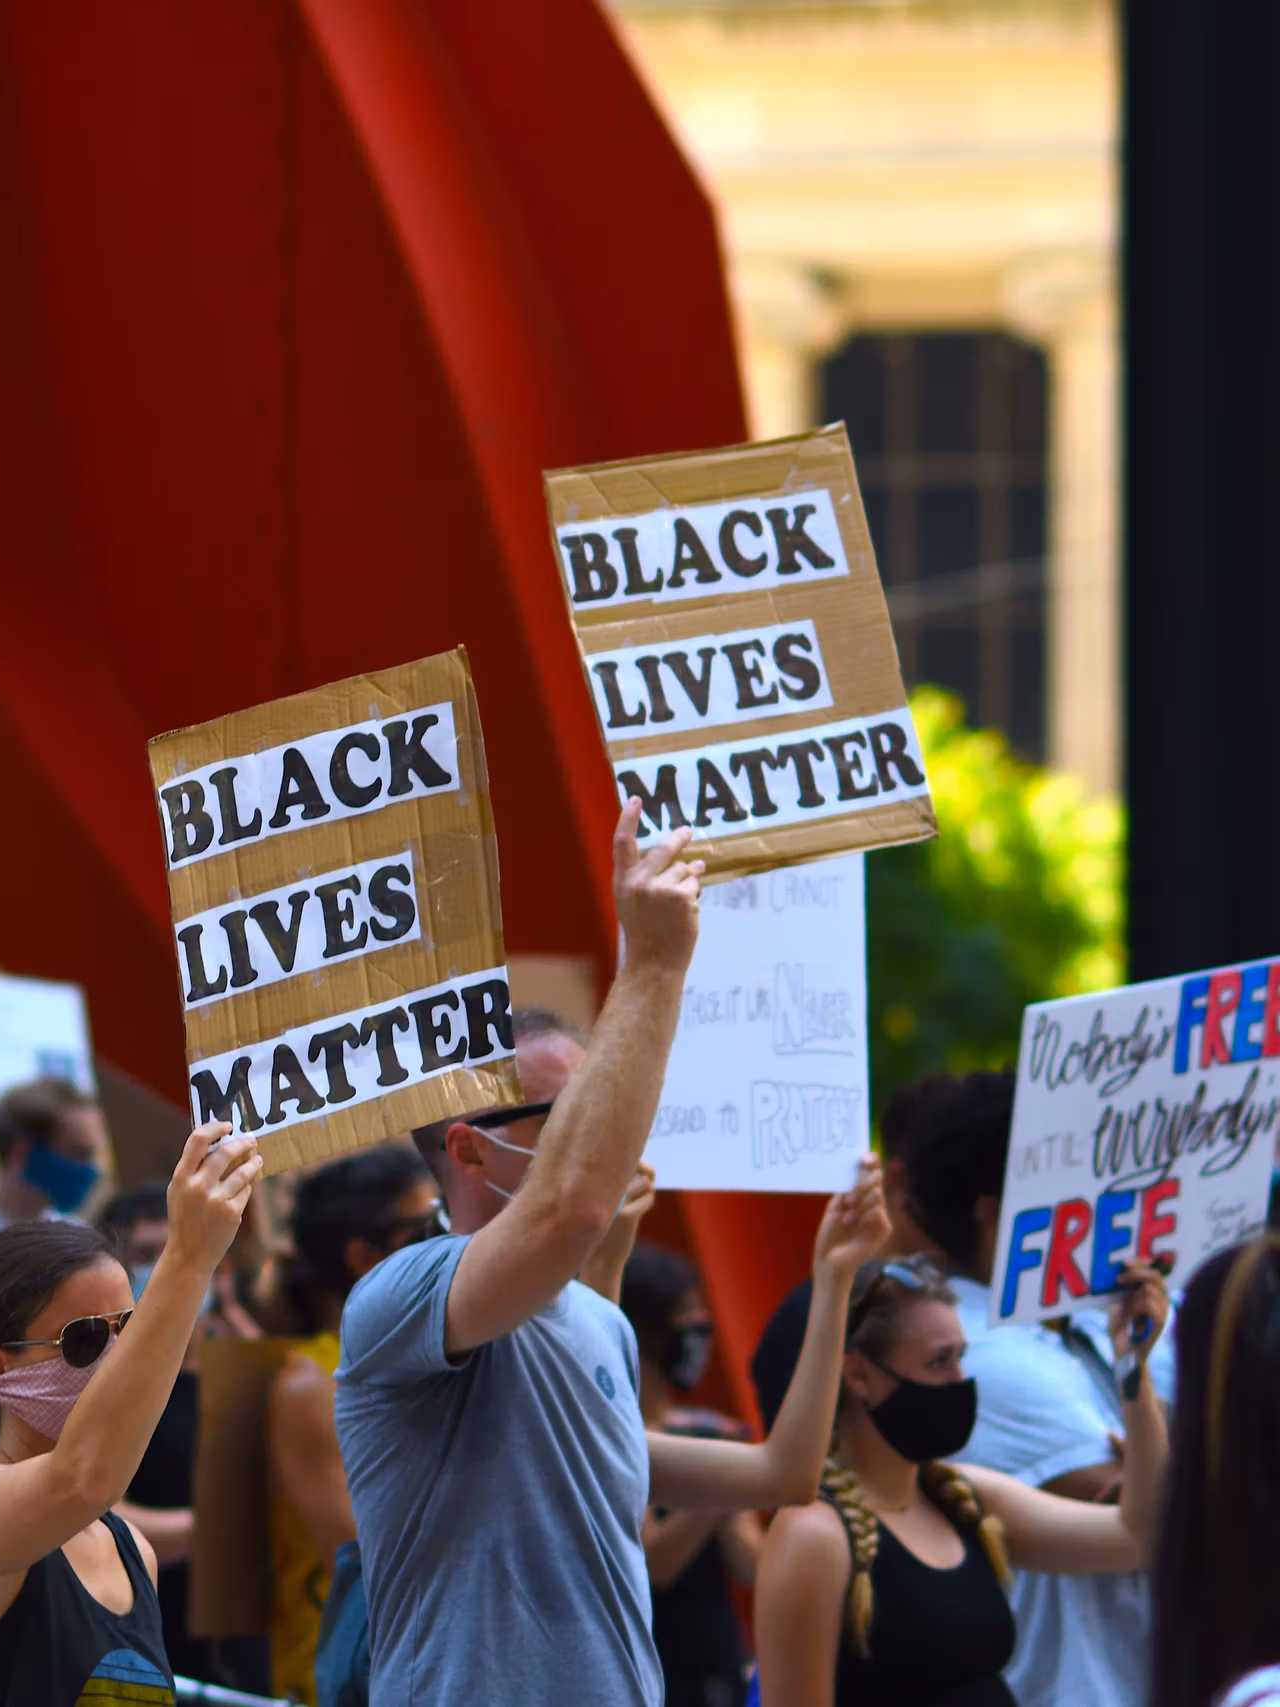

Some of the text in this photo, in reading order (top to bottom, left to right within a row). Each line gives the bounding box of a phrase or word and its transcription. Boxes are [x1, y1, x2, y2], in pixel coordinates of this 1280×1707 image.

[560, 503, 835, 603] BLACK
[592, 632, 821, 729] LIVES
[160, 712, 453, 863] BLACK
[617, 722, 925, 838] MATTER
[177, 863, 416, 1003] LIVES
[190, 978, 515, 1136] MATTER
[999, 1177, 1180, 1320] FREE
